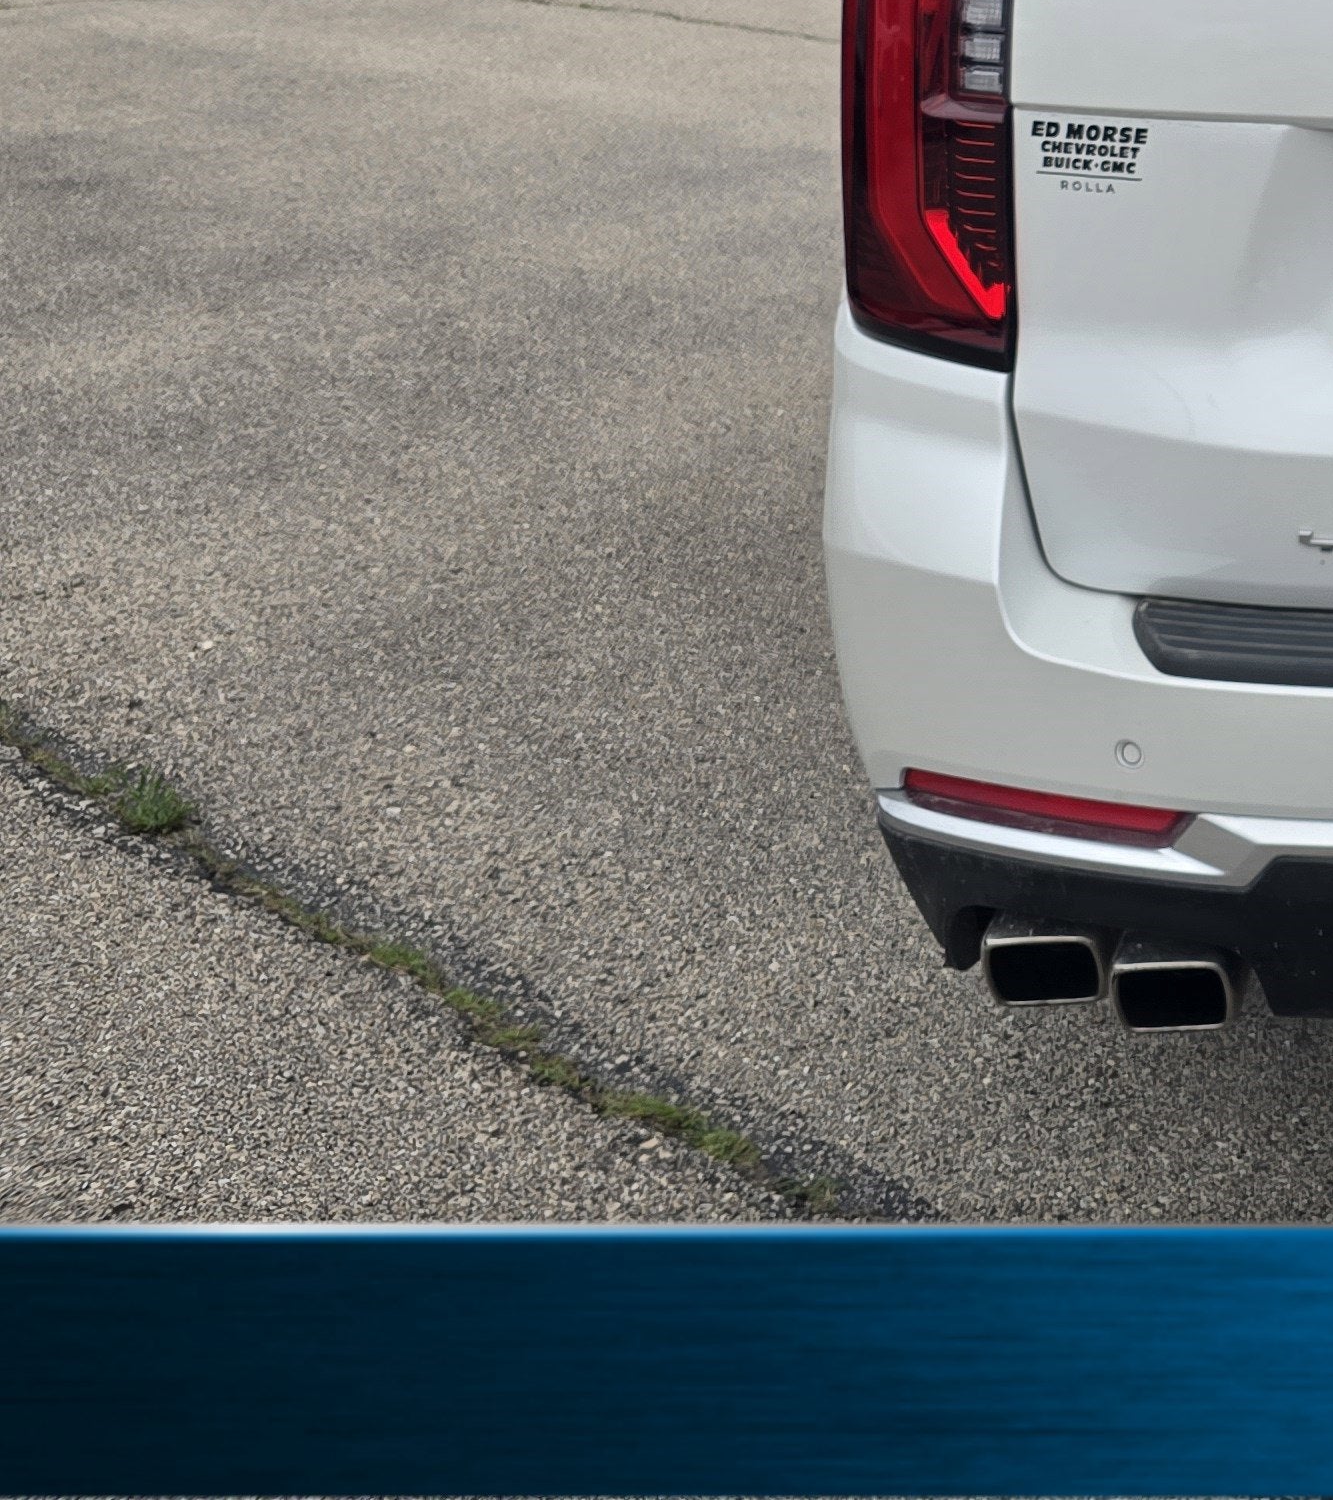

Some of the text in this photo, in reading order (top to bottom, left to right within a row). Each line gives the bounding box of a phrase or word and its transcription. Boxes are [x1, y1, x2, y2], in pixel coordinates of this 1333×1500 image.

[1031, 120, 1148, 145] ED MORSE
[1041, 140, 1140, 159] CHEVROLET
[1060, 179, 1116, 194] ROLLA
